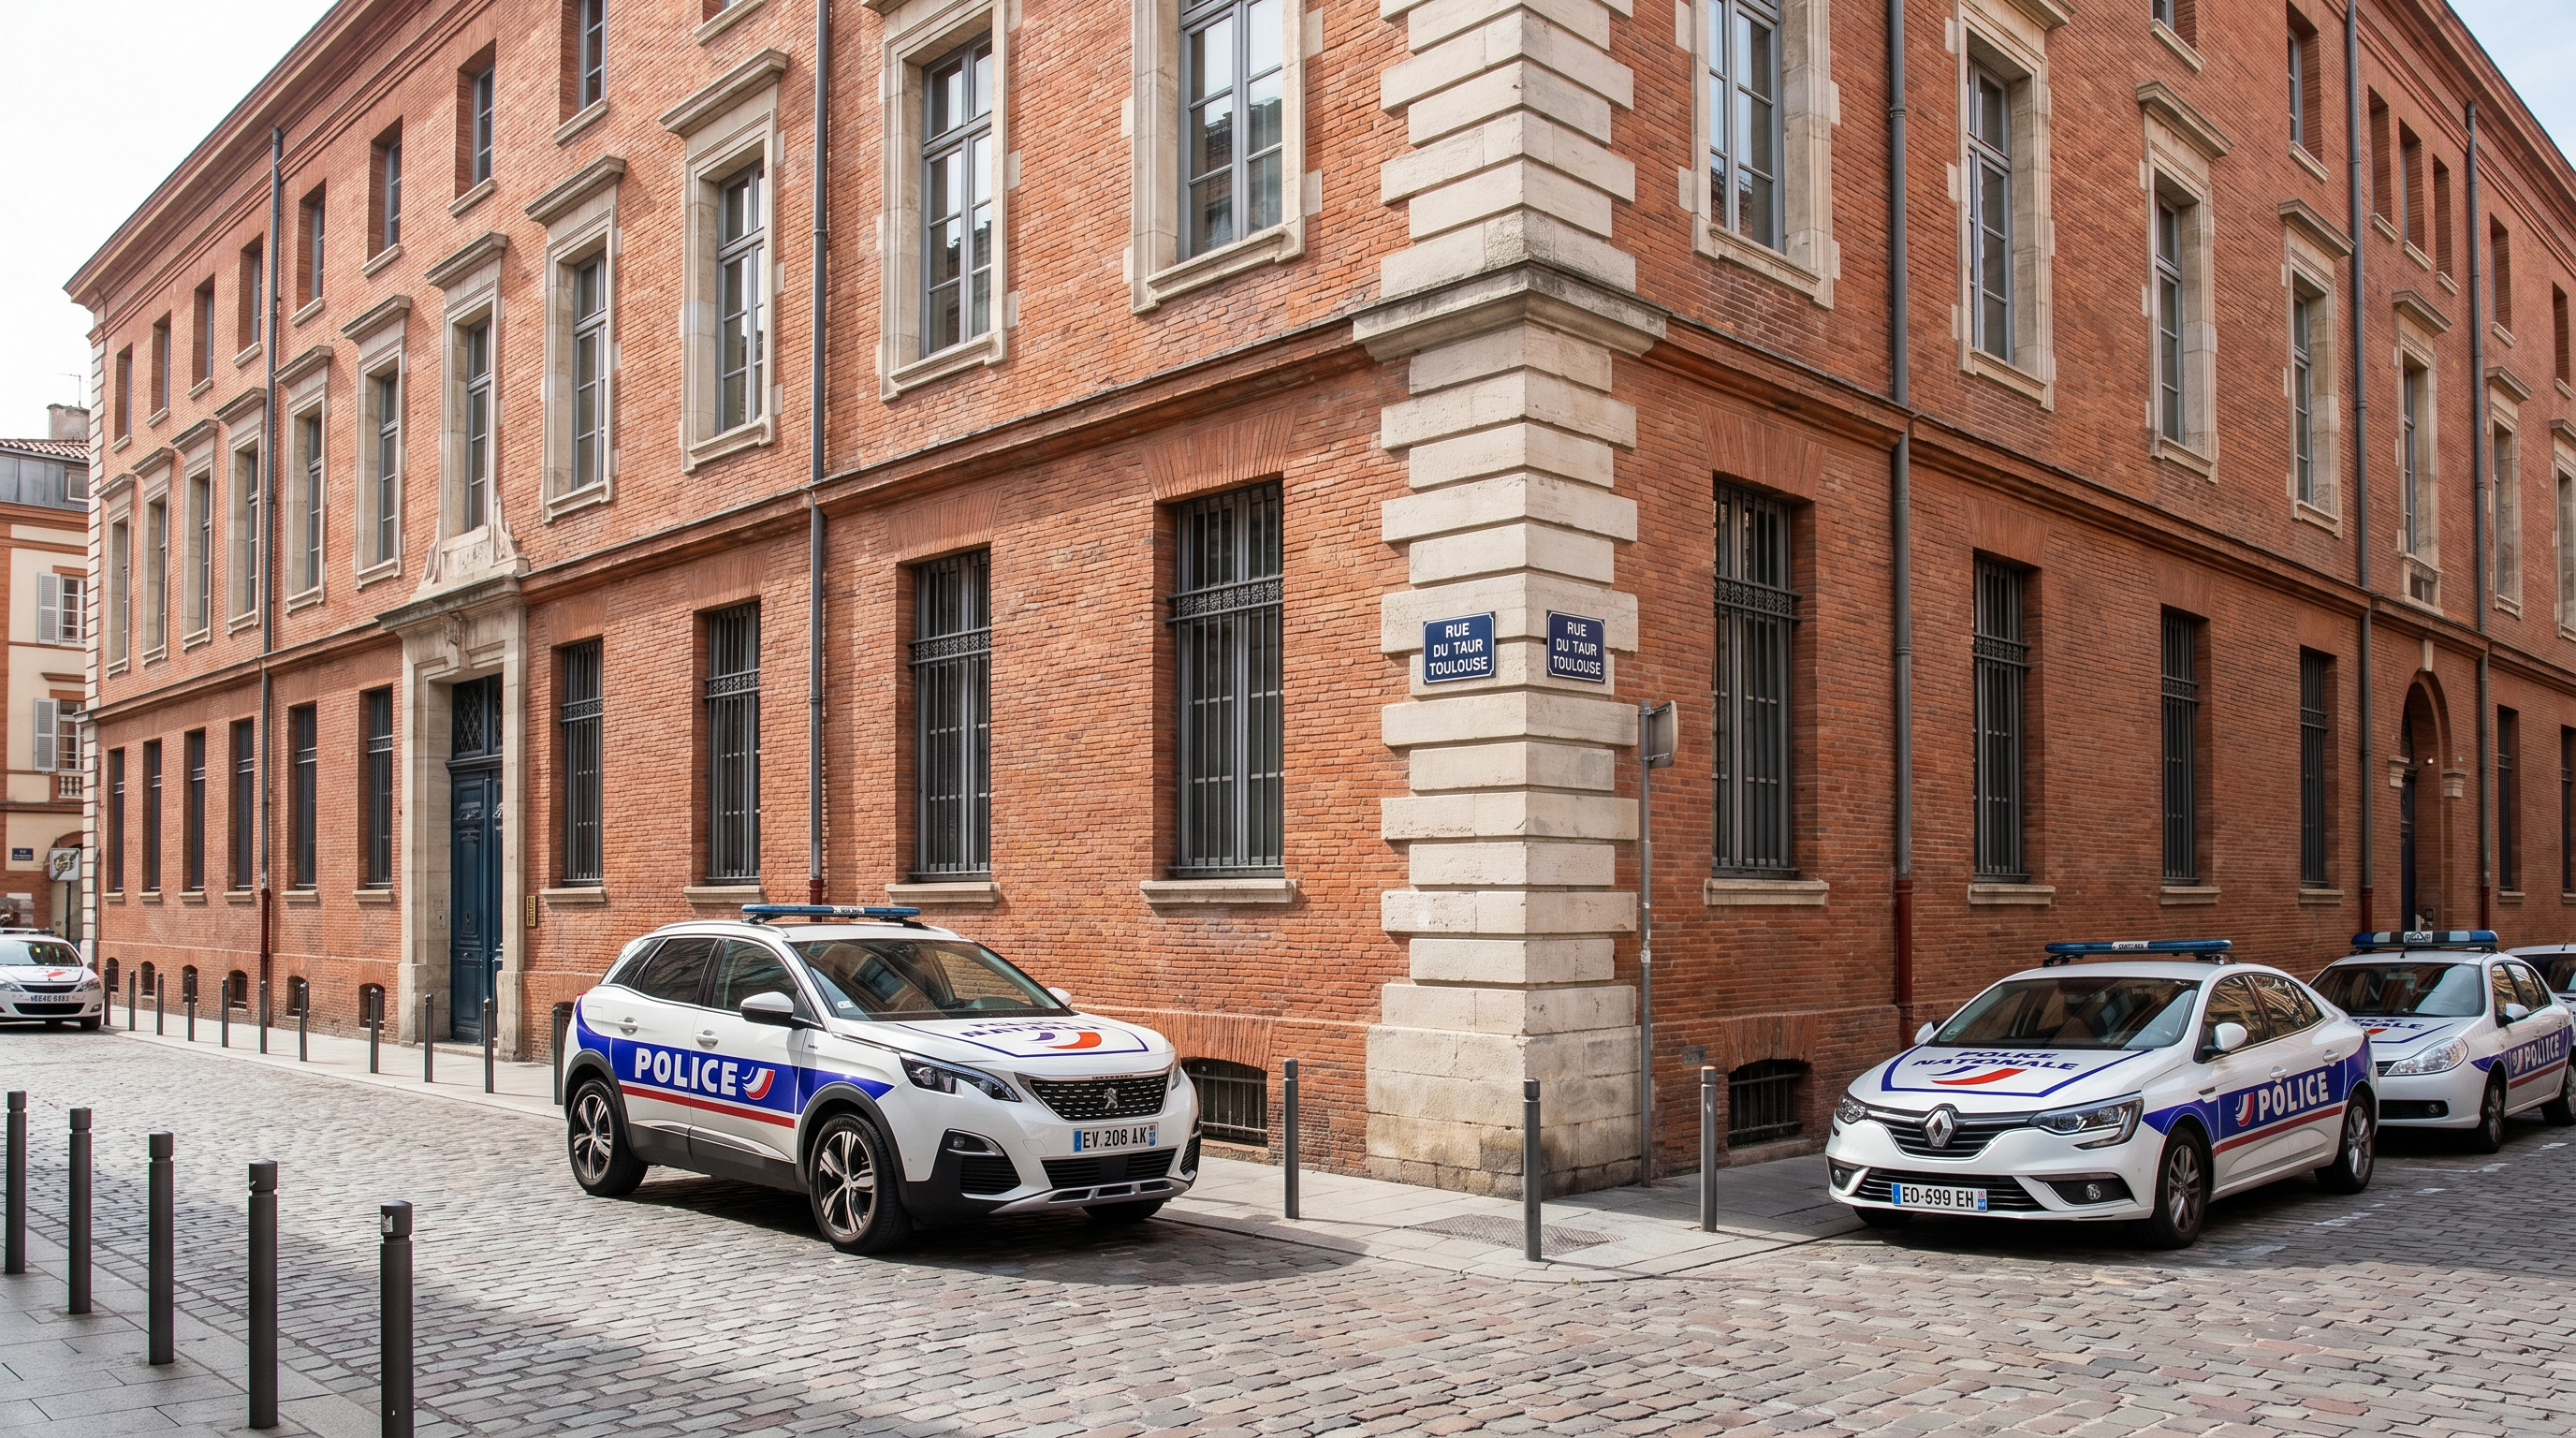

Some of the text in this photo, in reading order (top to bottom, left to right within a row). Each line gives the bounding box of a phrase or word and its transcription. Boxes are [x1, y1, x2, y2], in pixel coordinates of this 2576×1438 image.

[1445, 622, 1470, 638] RUE
[1567, 621, 1587, 638] RUE
[1433, 638, 1484, 658] DU TAUR
[1556, 638, 1597, 656] DU TAUR
[1429, 656, 1488, 676] TOULOUSE
[1553, 655, 1602, 675] TOULOUSE
[635, 1047, 739, 1096] POLICE
[2258, 1071, 2329, 1122] POLICE
[1132, 1126, 1147, 1144] AK
[1955, 1190, 1974, 1208] EH
